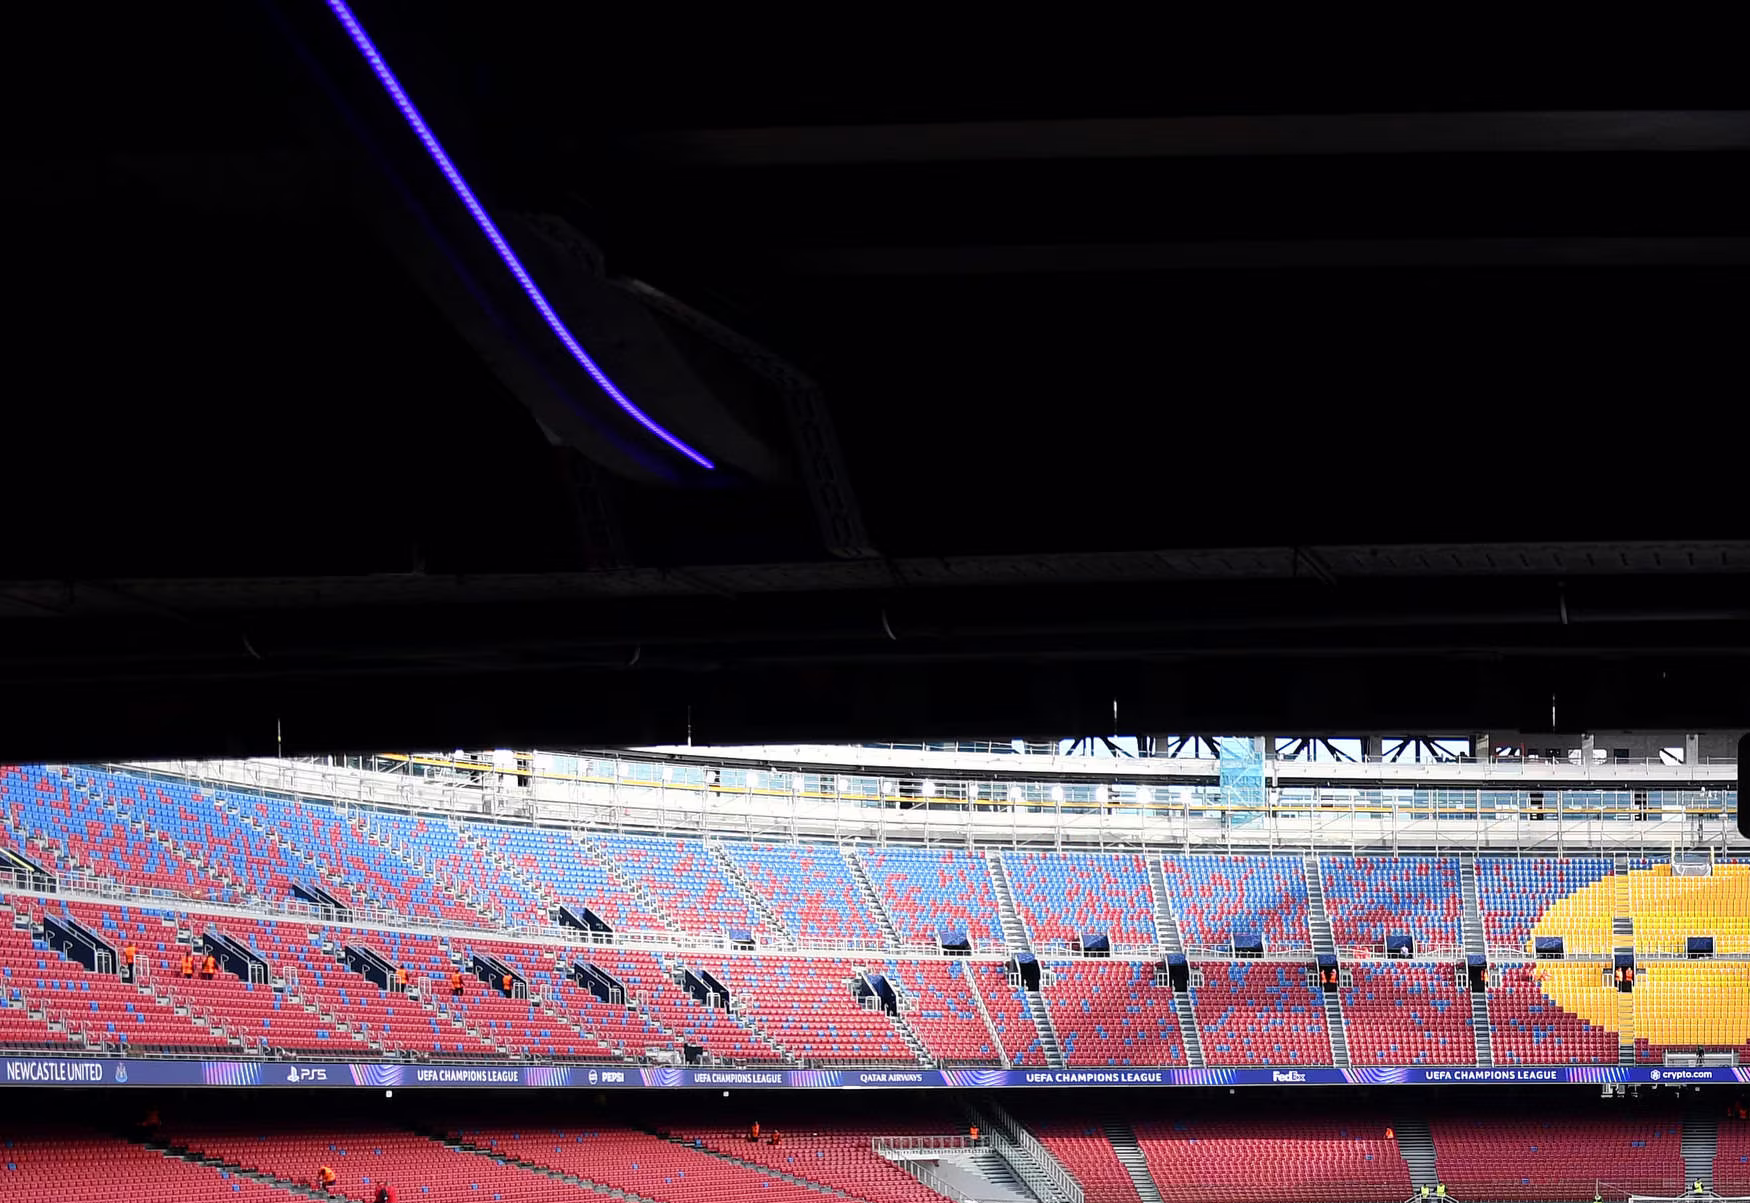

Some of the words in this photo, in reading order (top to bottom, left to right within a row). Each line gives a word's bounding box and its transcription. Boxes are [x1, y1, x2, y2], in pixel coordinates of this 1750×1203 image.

[6, 1061, 66, 1081] NEWCASTLE
[67, 1063, 103, 1081] UNITED
[301, 1068, 328, 1080] PS5
[417, 1069, 438, 1081] UEFA
[439, 1070, 487, 1082] CHAMPIONS
[487, 1071, 519, 1082] LEAGUE
[1273, 1071, 1306, 1082] FedEx
[1425, 1071, 1452, 1080] UEFA
[1454, 1070, 1516, 1080] CHAMPIONS
[1517, 1070, 1557, 1080] LEAGUE
[1662, 1070, 1713, 1080] crypto.com
[602, 1072, 624, 1083] PEPSI
[694, 1073, 711, 1083] UEFA
[712, 1072, 752, 1083] CHAMPIONS
[752, 1073, 782, 1083] LEAGUE
[860, 1074, 887, 1083] QATAR
[888, 1073, 923, 1082] AIRWAYS
[1026, 1073, 1053, 1082] UEFA
[1055, 1073, 1119, 1082] CHAMPIONS
[1120, 1073, 1162, 1082] LEAGUE
